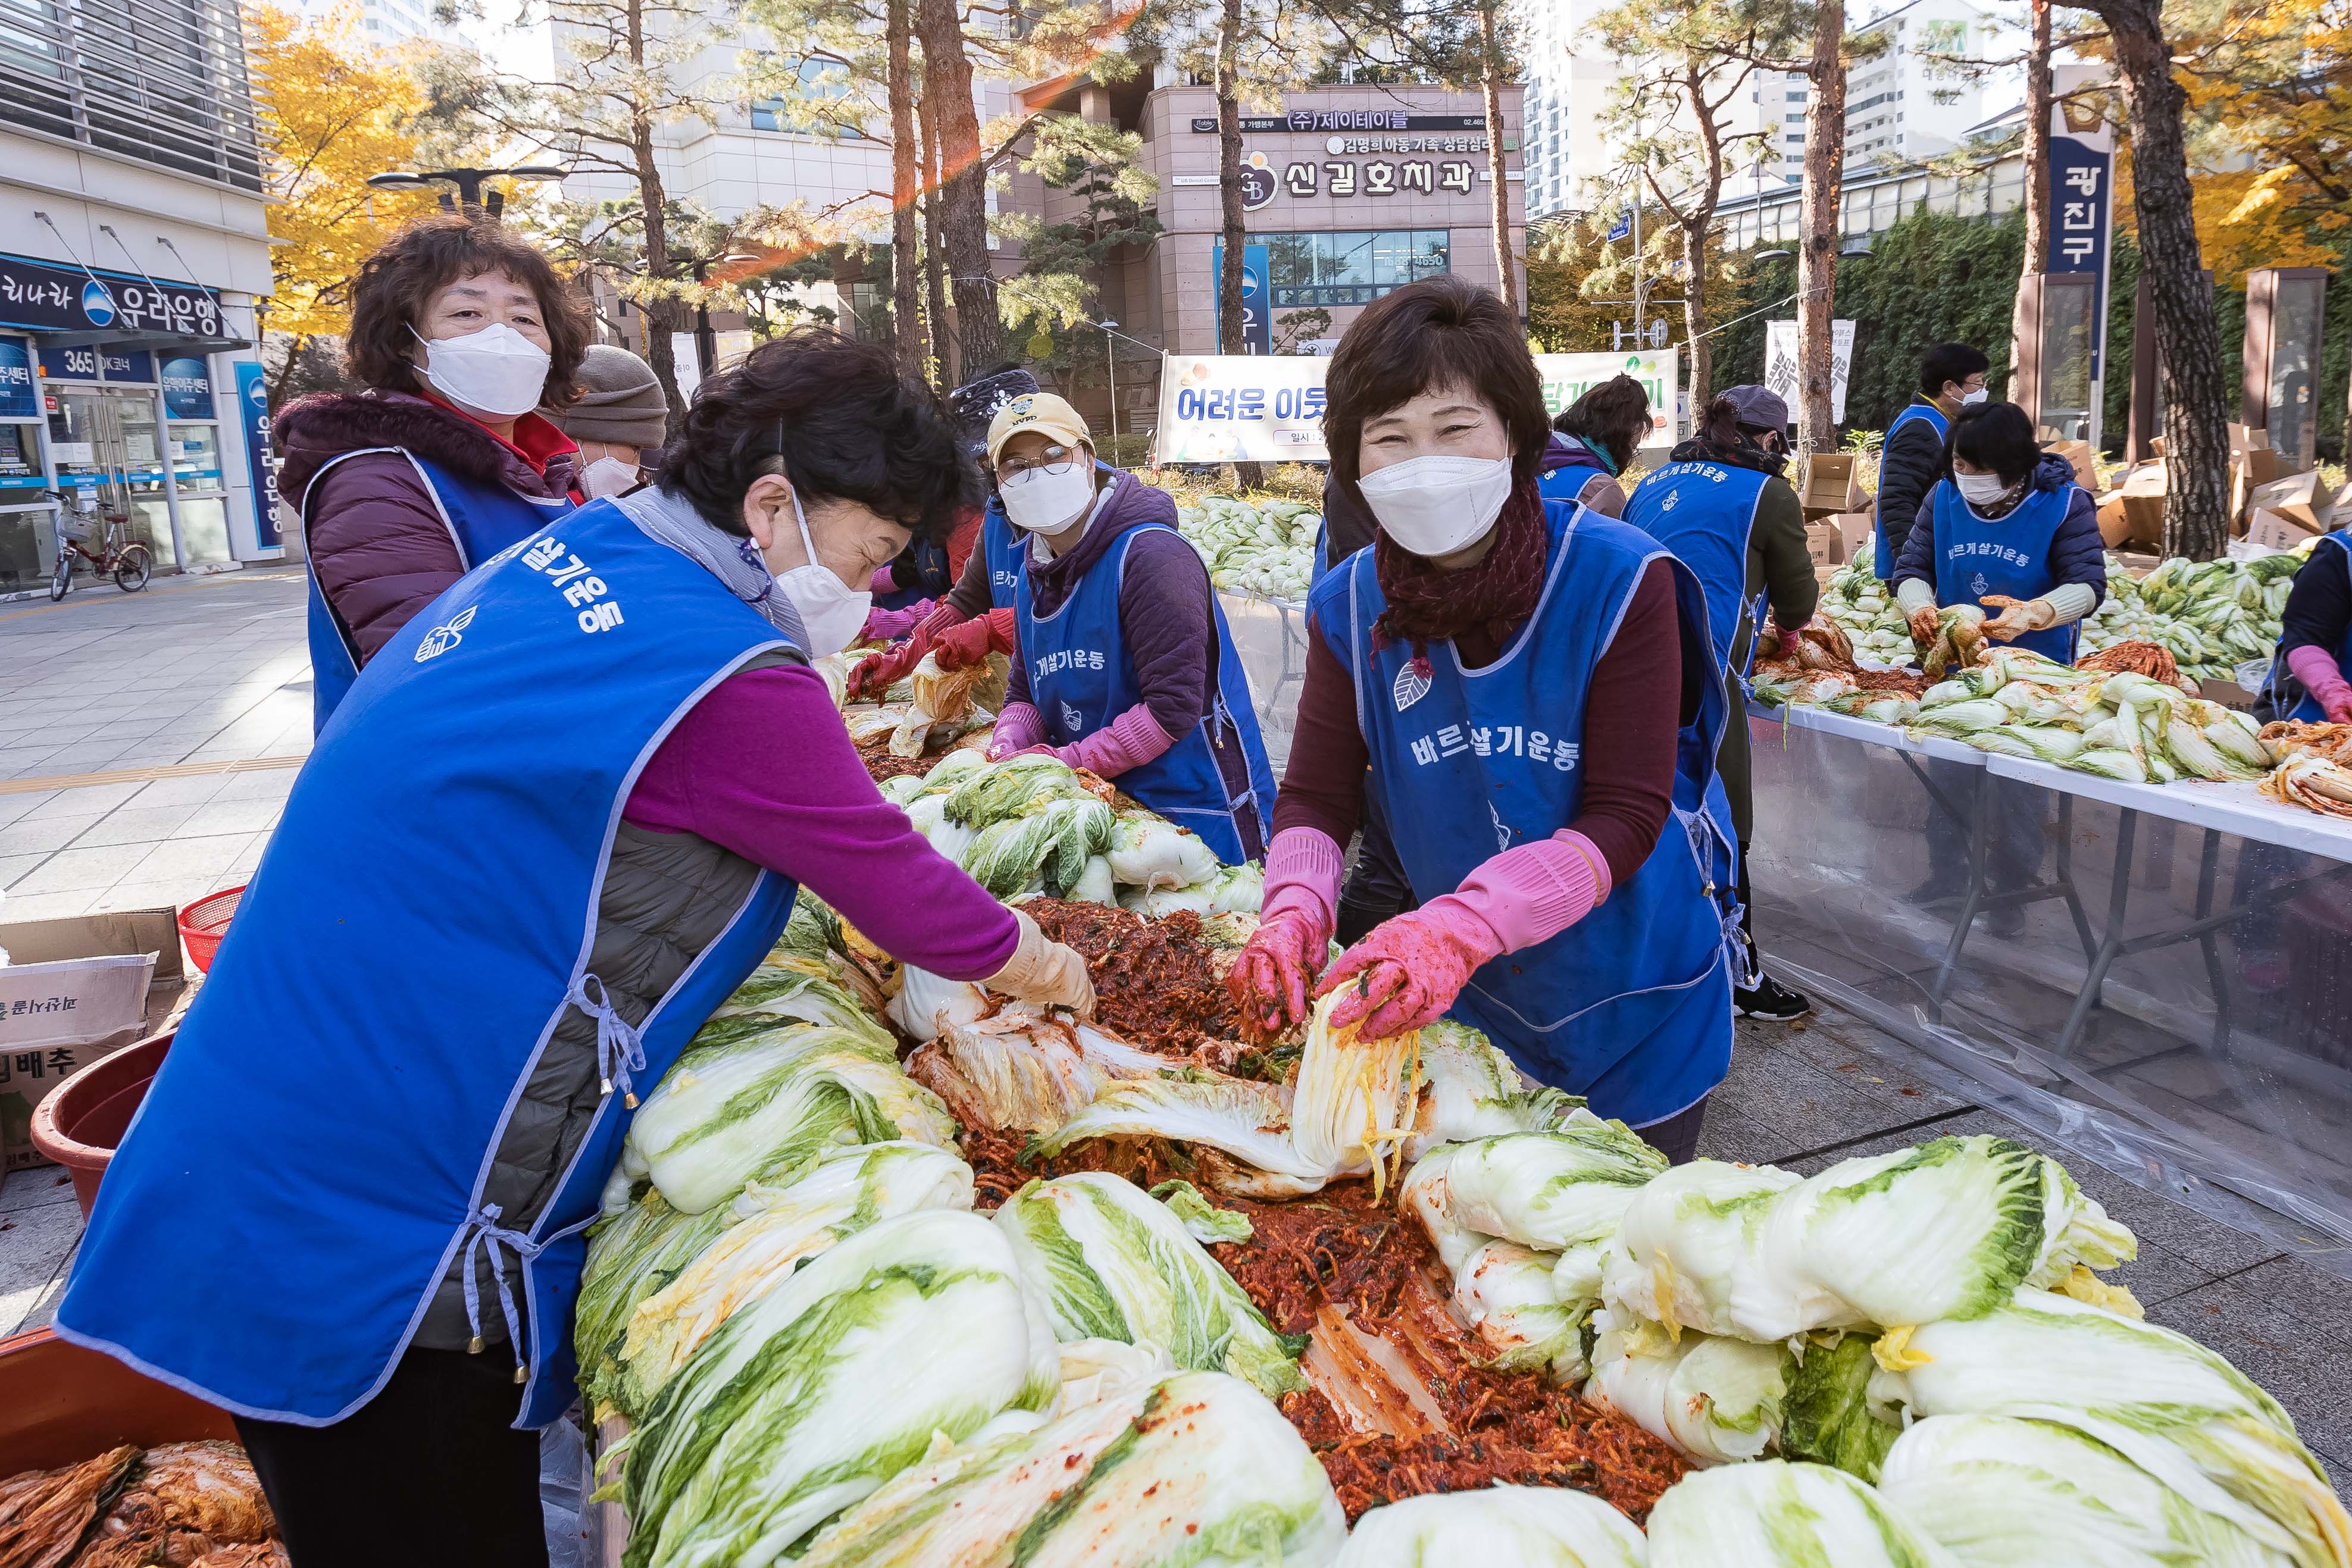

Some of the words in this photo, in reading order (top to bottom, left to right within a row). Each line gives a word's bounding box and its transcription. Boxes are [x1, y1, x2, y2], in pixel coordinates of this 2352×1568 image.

[1247, 120, 1274, 129] 가맹본부
[1414, 137, 1440, 152] 가족
[1286, 161, 1473, 196] 신길호치과
[2062, 167, 2101, 274] 광진구
[122, 287, 217, 336] 우리은행
[65, 351, 95, 373] 365
[1178, 389, 1265, 421] 어려운
[1275, 387, 1329, 420] 이웃
[1291, 433, 1309, 443] 일시
[1646, 461, 1728, 486] 바르게살기운동
[1410, 720, 1581, 772] 바르살기운동
